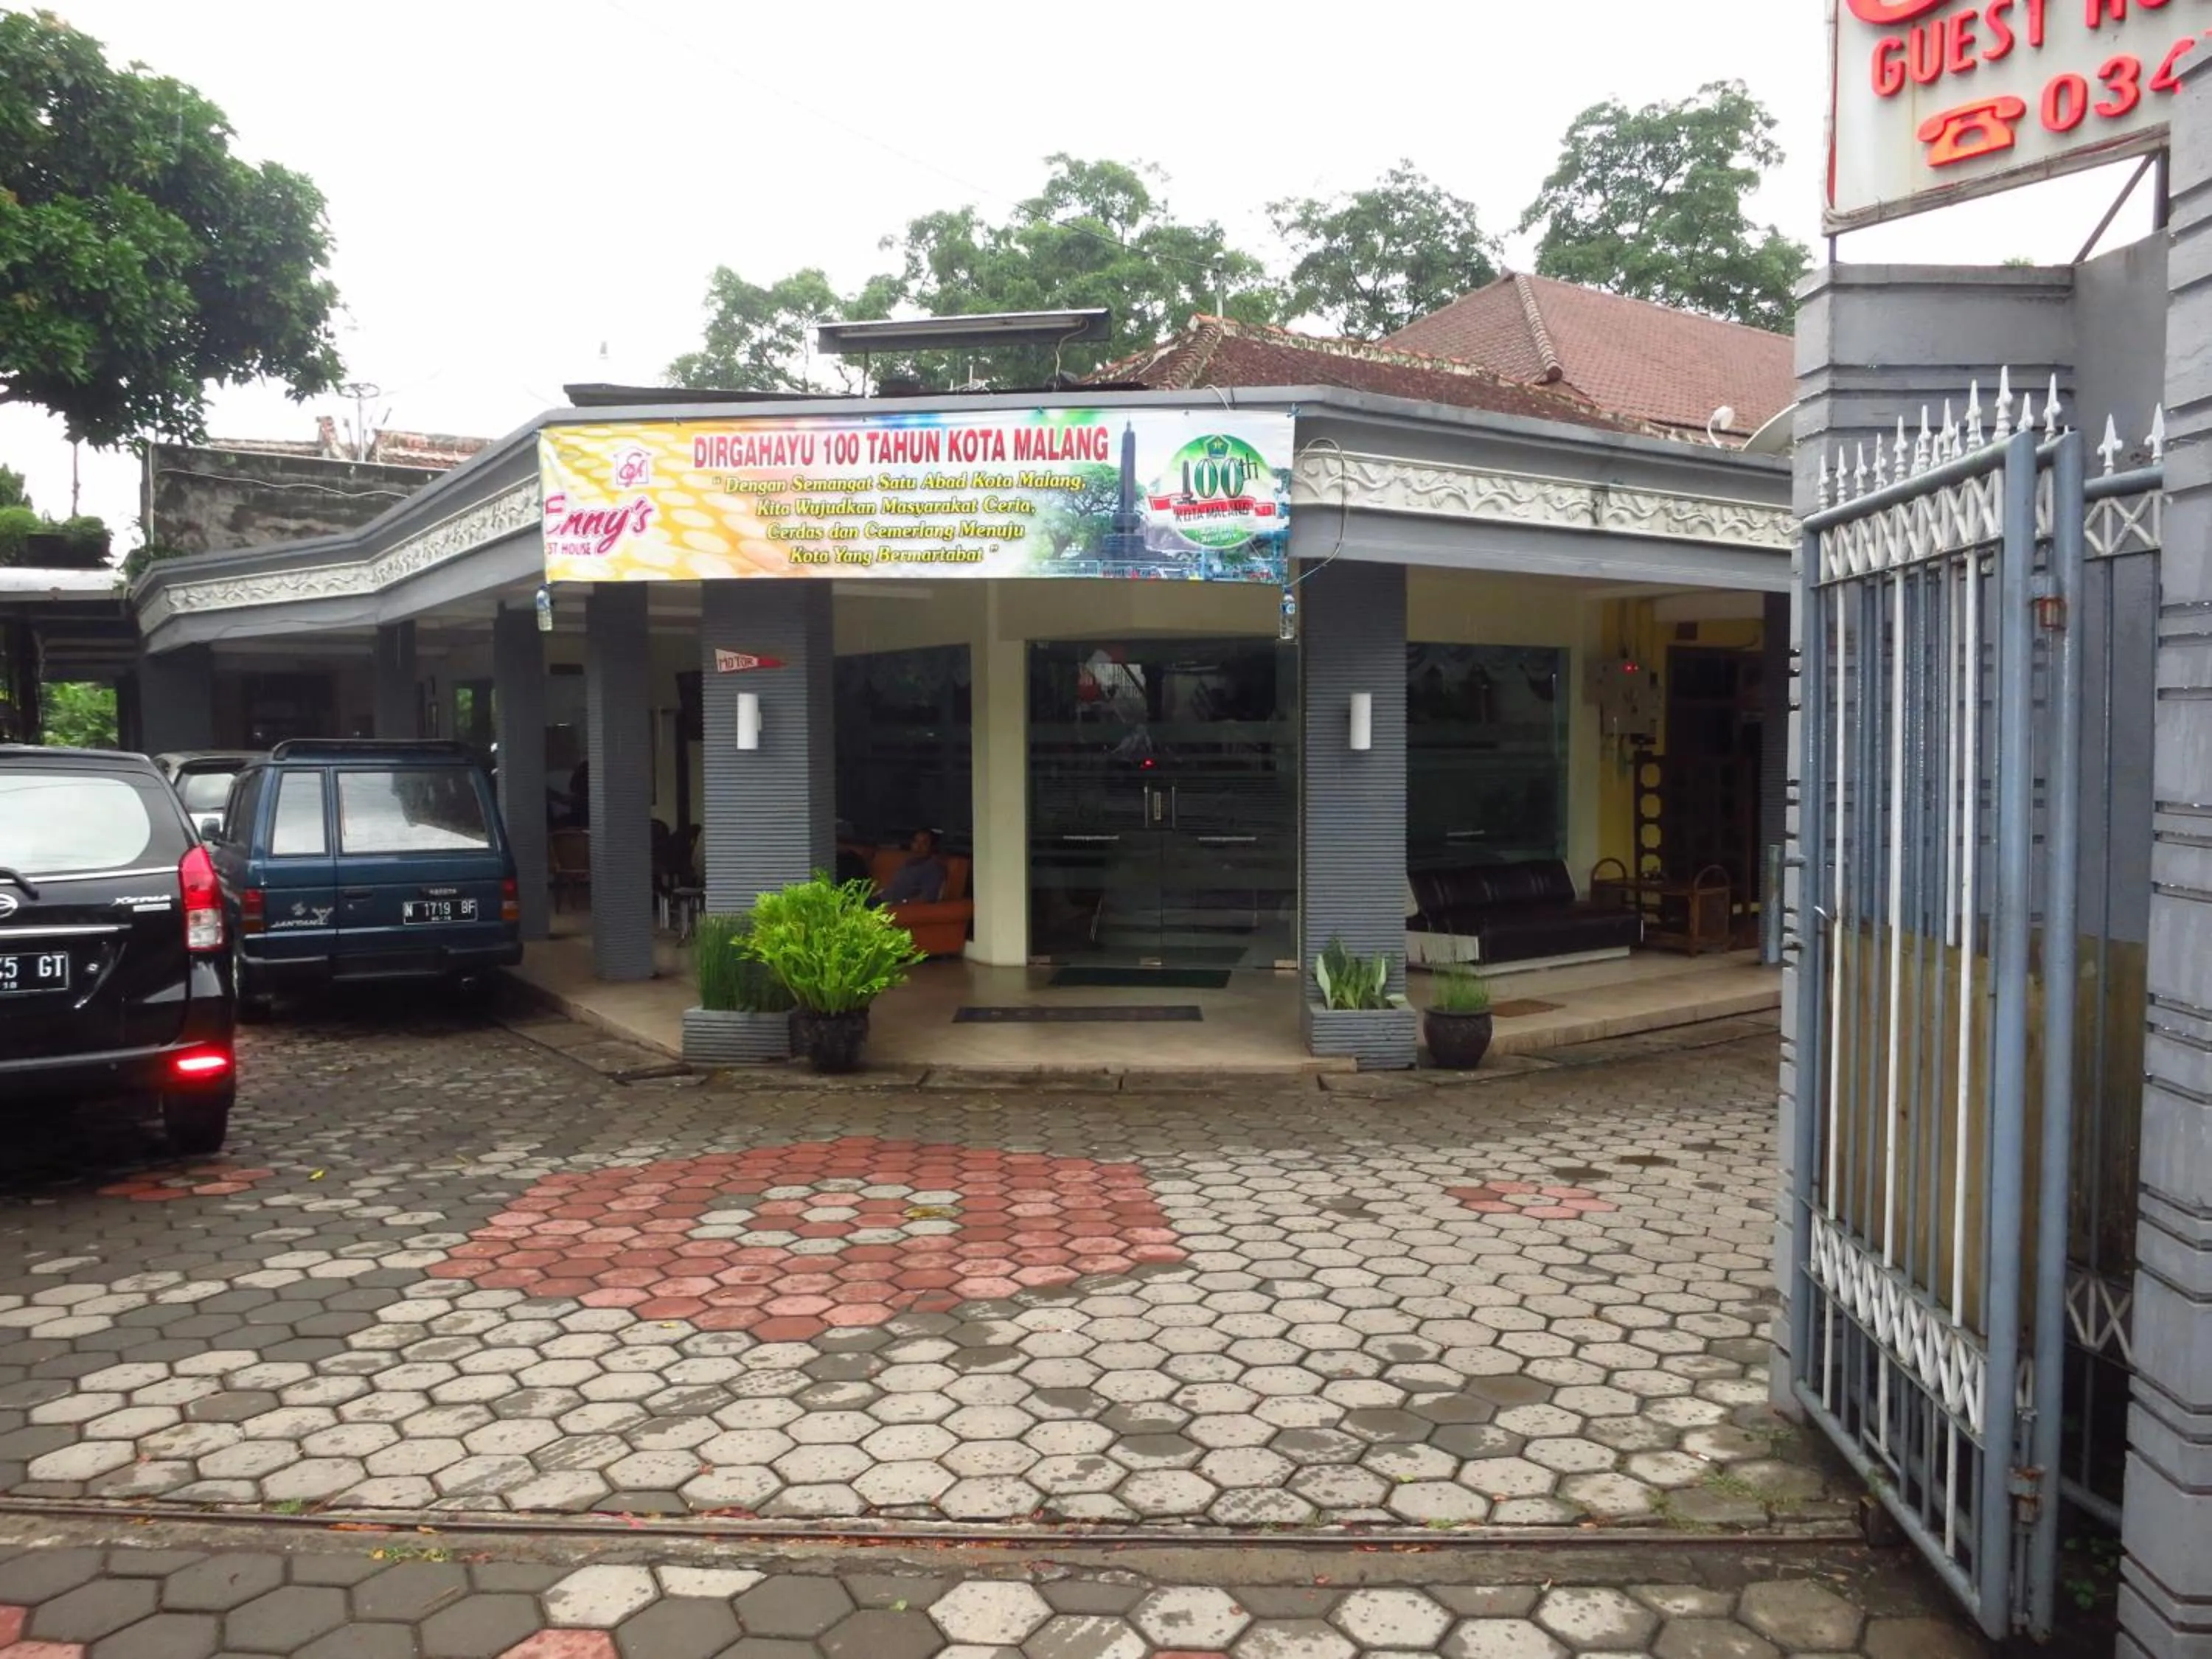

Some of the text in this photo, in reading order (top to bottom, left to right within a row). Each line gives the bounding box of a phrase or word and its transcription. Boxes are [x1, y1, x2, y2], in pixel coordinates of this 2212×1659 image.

[1871, 0, 2045, 97] GUEST
[2039, 28, 2212, 133] 034
[694, 426, 1109, 468] DIRGAHAYU 100 TAHUN KOTA MALANG
[725, 476, 787, 496] Dengan
[791, 474, 874, 495] Semangat
[877, 473, 917, 491] Satu
[921, 471, 967, 490] Abad
[970, 471, 1013, 490] Kota
[1016, 470, 1087, 492] Malang,
[756, 498, 791, 516] Kita
[794, 498, 877, 519] Wujudkan
[880, 496, 977, 517] Masyarakat
[767, 519, 1026, 541] Cerdas dan Cemerlang Menuju
[562, 542, 591, 554] HOUSE
[790, 546, 830, 564] Kota
[832, 546, 873, 566] Yang
[876, 544, 984, 563] Bermartabat
[38, 954, 66, 978] GT
